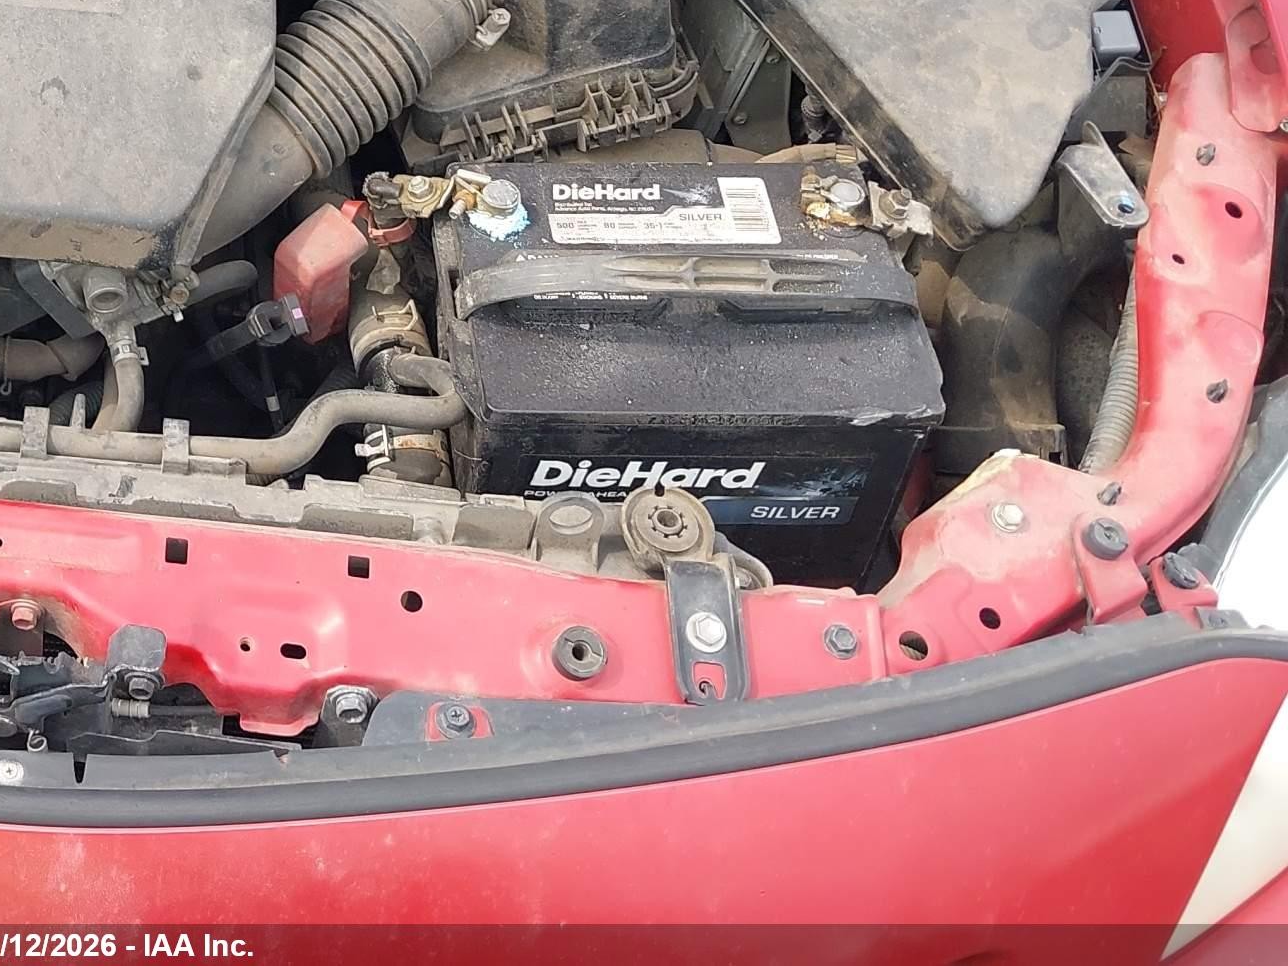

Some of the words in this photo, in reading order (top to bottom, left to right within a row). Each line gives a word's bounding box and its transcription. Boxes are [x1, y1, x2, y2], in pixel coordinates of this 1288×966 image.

[552, 183, 661, 201] DieHard
[679, 213, 722, 221] SILVER
[529, 460, 766, 489] DieHard
[750, 505, 840, 520] SILVER
